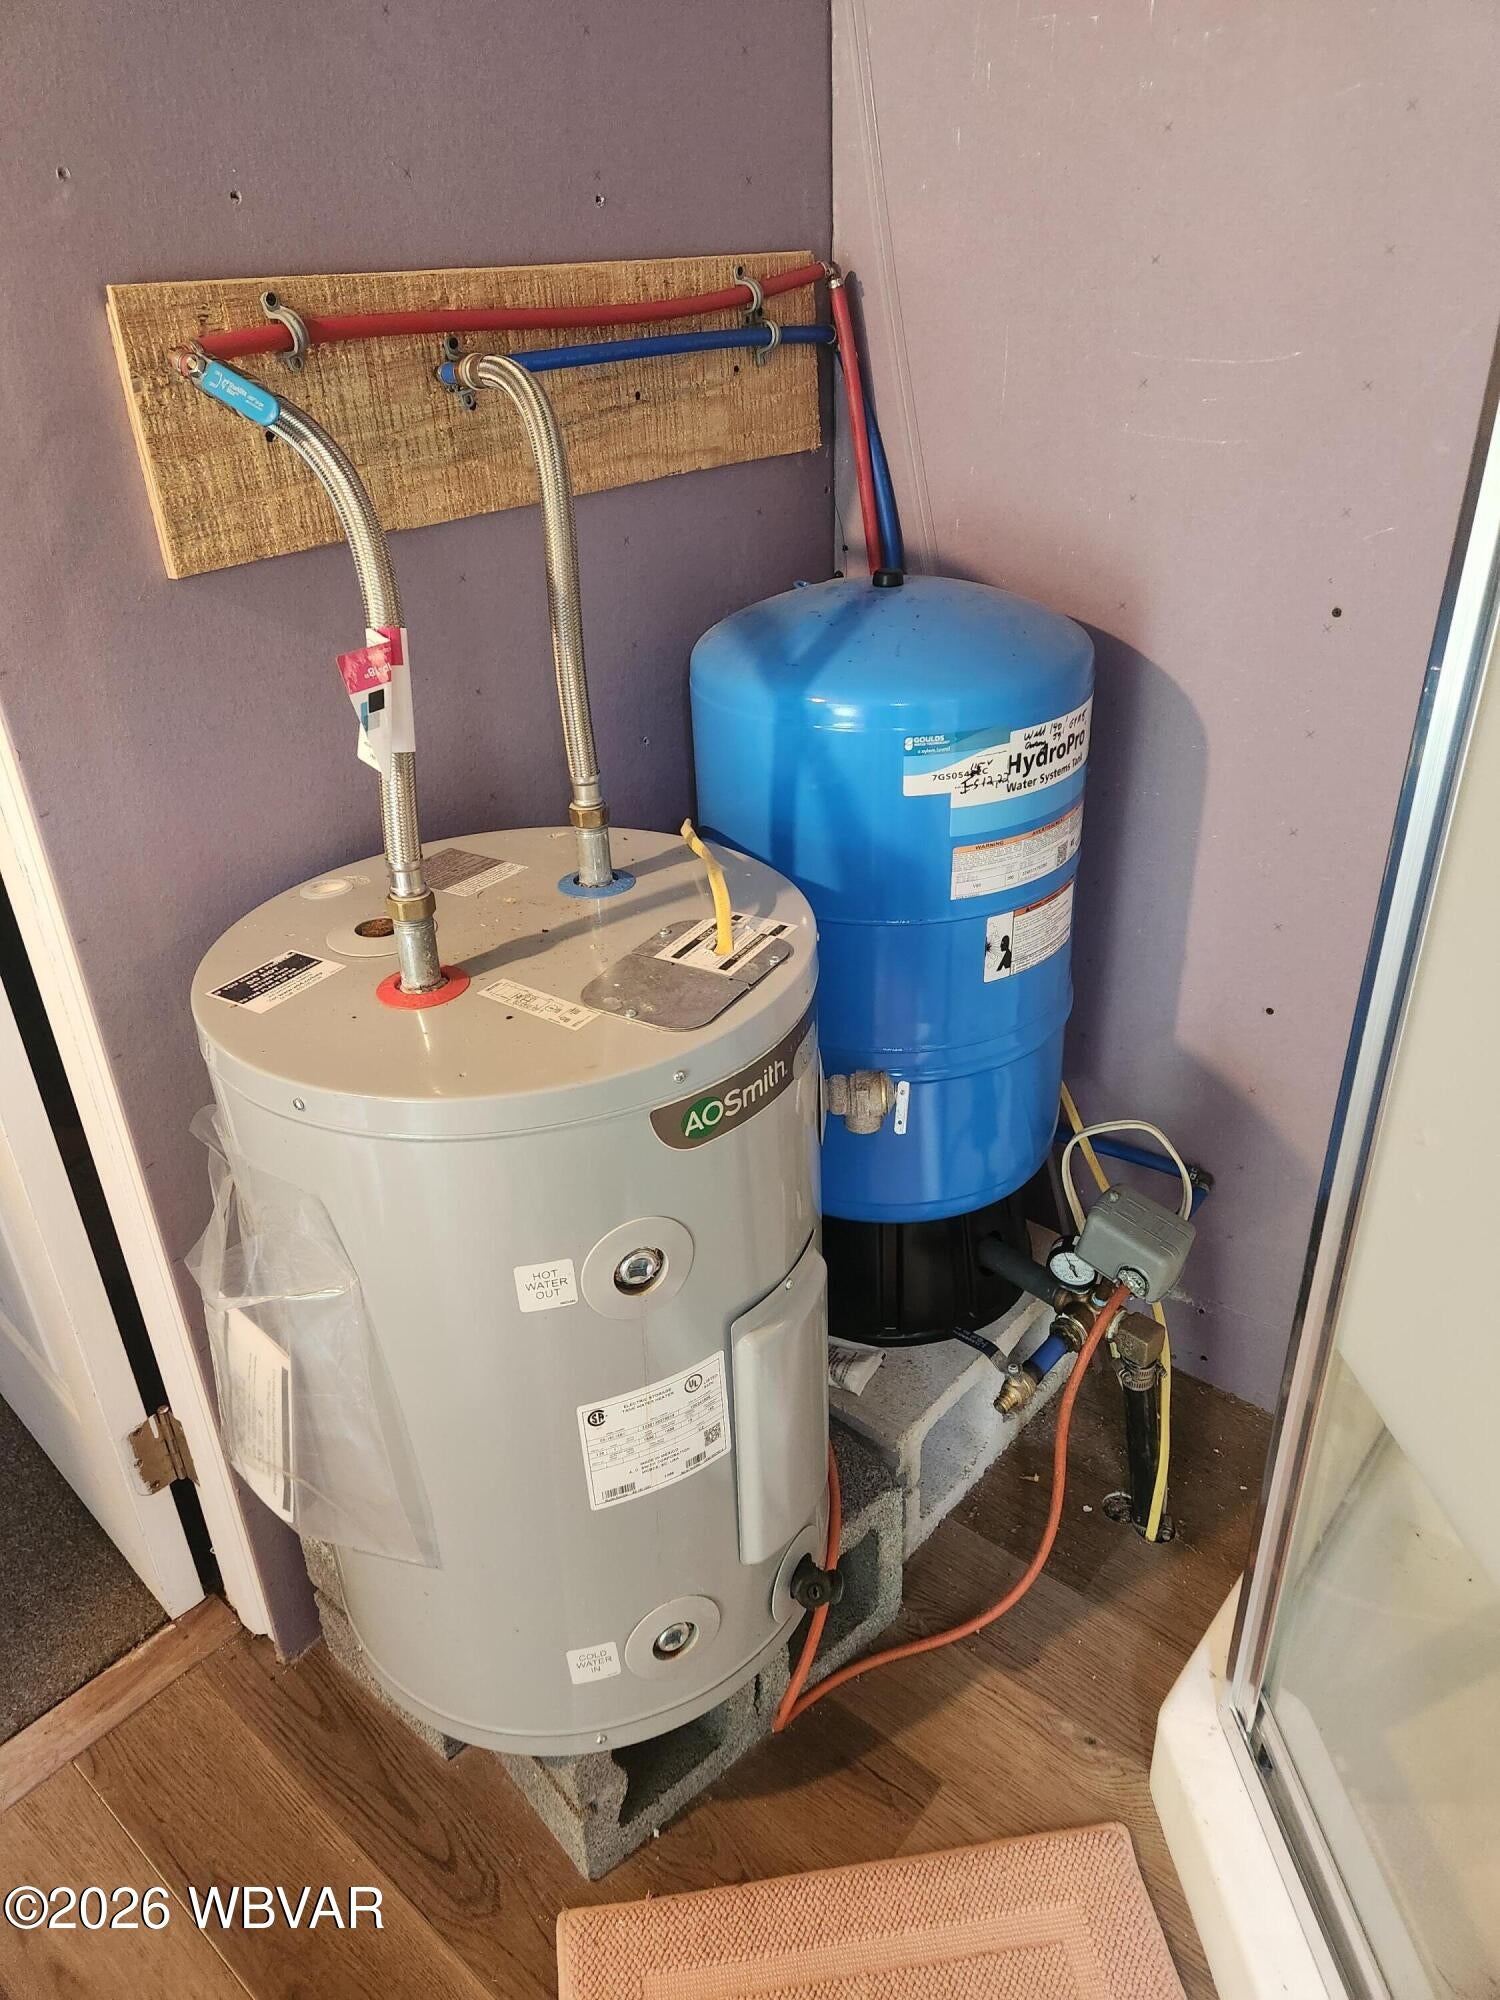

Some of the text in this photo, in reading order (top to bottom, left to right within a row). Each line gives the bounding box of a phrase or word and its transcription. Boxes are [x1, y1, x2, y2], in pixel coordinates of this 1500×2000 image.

[914, 735, 944, 743] GOULDS
[1008, 729, 1085, 778] HydroPro
[1006, 778, 1037, 793] Water
[1040, 763, 1071, 785] Systems
[684, 1059, 786, 1137] AOSmith
[532, 1269, 558, 1281] HOT
[525, 1277, 568, 1291] WATER
[536, 1288, 561, 1299] OUT
